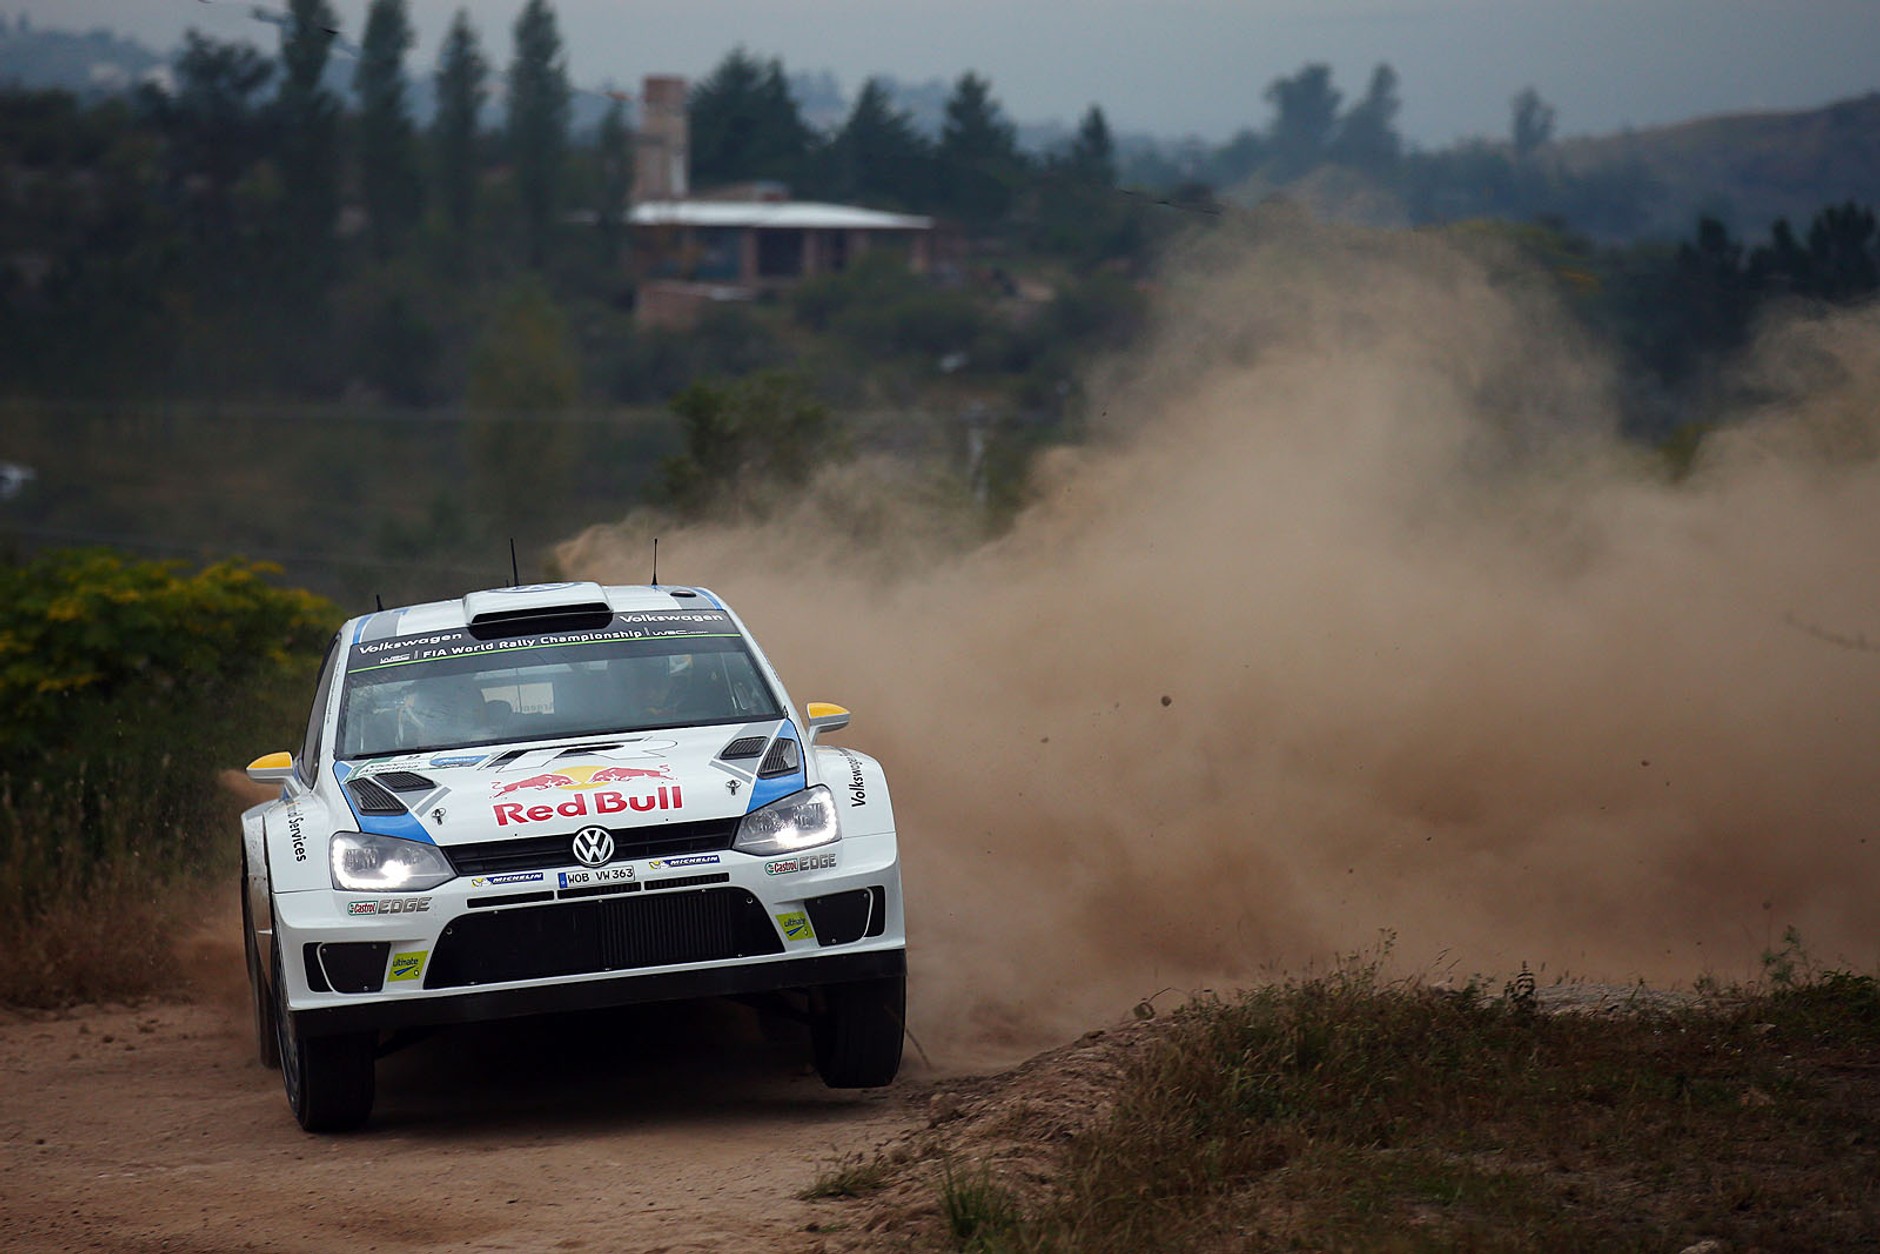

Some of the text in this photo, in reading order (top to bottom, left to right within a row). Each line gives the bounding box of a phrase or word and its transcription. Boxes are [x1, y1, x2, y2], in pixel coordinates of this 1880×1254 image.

[619, 613, 724, 623] Volkswagen
[358, 632, 463, 655] Volkswagen
[422, 649, 448, 659] FIA
[451, 642, 494, 655] World
[499, 638, 536, 650] Rally
[540, 629, 643, 645] Championship
[492, 785, 684, 827] Red Bull
[288, 816, 308, 863] Services
[669, 855, 719, 866] MICHELIN
[774, 853, 837, 873] Castrol EDGE
[492, 873, 543, 883] MICHELIN
[567, 868, 634, 884] WOB VW 363
[354, 896, 433, 915] Castrol EDGE
[392, 956, 419, 968] ultimate
